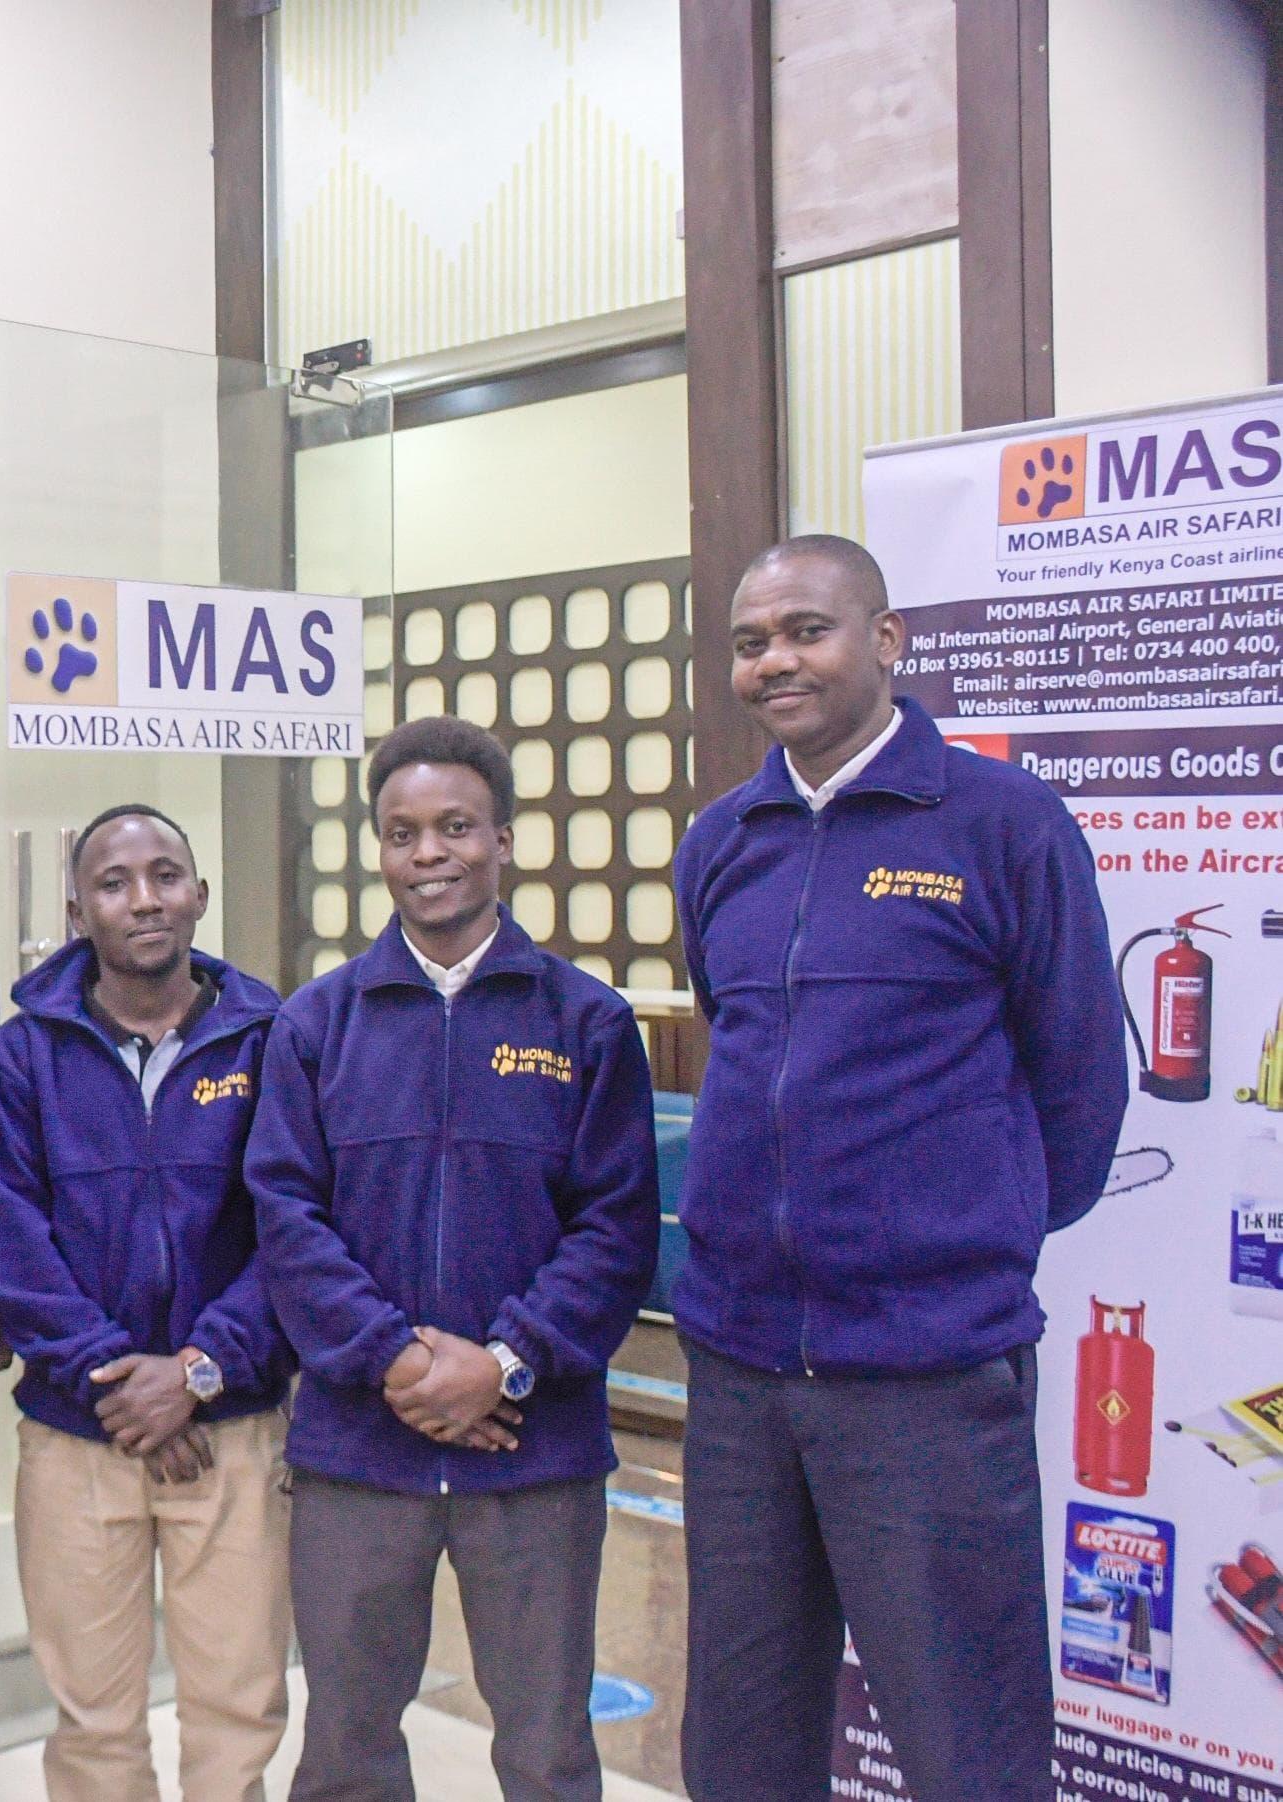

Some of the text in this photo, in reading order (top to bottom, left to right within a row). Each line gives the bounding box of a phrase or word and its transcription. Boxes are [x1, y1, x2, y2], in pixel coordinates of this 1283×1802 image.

[1098, 420, 1282, 503] MAS
[1007, 507, 1281, 552] MOMBASA AIR SAFARI
[997, 568, 1036, 582] Your
[1042, 561, 1104, 579] friendly
[1110, 558, 1164, 575] Kenya
[1171, 551, 1223, 568] Coast
[986, 599, 1081, 621] MOMBASA
[1086, 596, 1124, 614] AIR
[1129, 589, 1203, 611] SAFARI
[147, 599, 336, 696] MAS
[912, 607, 1283, 652] Moi International Airport, General Aviati
[920, 657, 945, 673] Box
[949, 647, 1070, 670] 93961-80115
[1092, 644, 1128, 662] Tel:
[1134, 641, 1184, 660] 0734
[1189, 637, 1229, 656] 400
[1234, 634, 1281, 656] 400,
[953, 674, 1008, 693] Email:
[958, 698, 1039, 715] Website:
[13, 713, 352, 751] MOMBASA AIR SAFARI
[1021, 752, 1161, 787] Dangerous
[1171, 746, 1260, 778] Goods
[1133, 810, 1186, 830] can
[1196, 805, 1232, 830] be
[1243, 809, 1283, 830] ex
[1097, 853, 1131, 872] on
[1142, 848, 1189, 873] the
[891, 884, 962, 904] AIR SAFARI
[895, 870, 964, 890] MOMBASA
[517, 1061, 536, 1073] AIR
[1078, 1525, 1161, 1561] LOCTITE
[1096, 1705, 1173, 1743] luggage
[1179, 1733, 1199, 1749] or
[1206, 1741, 1230, 1758] on
[1237, 1749, 1275, 1770] you
[1054, 1725, 1098, 1759] lude
[1102, 1745, 1184, 1784] articles
[1190, 1771, 1230, 1799] and
[1237, 1784, 1283, 1802] sub
